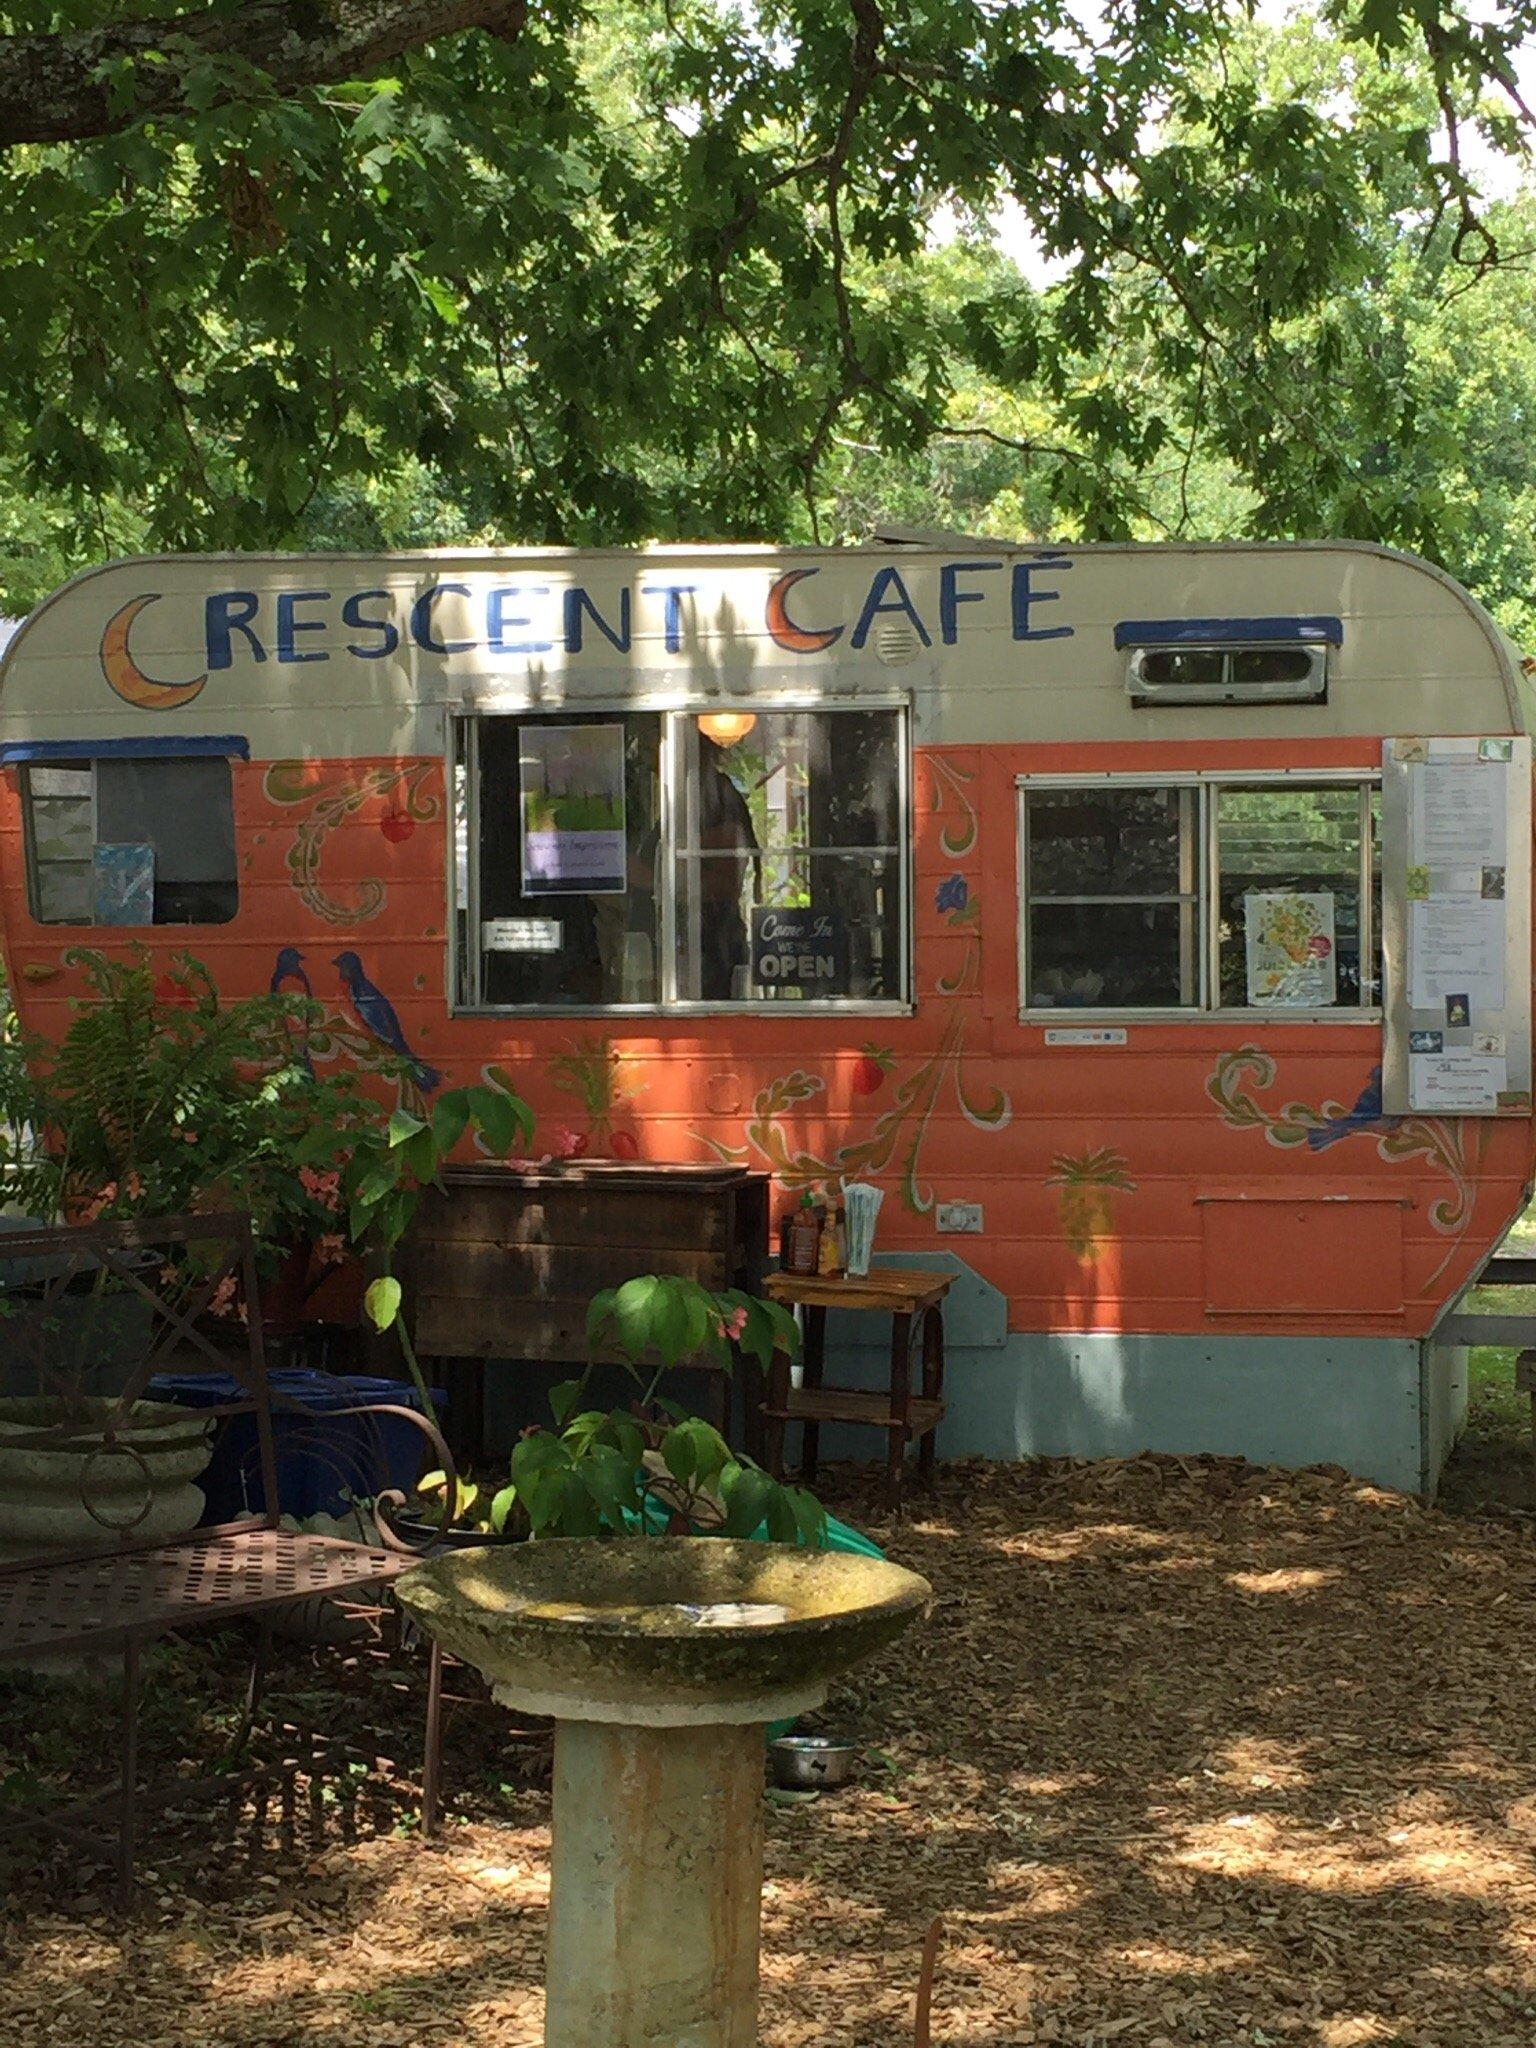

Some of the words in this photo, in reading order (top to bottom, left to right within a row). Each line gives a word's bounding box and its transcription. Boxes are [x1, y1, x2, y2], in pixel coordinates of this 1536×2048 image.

[761, 914, 804, 941] Come
[809, 915, 833, 938] In
[759, 954, 834, 978] OPEN
